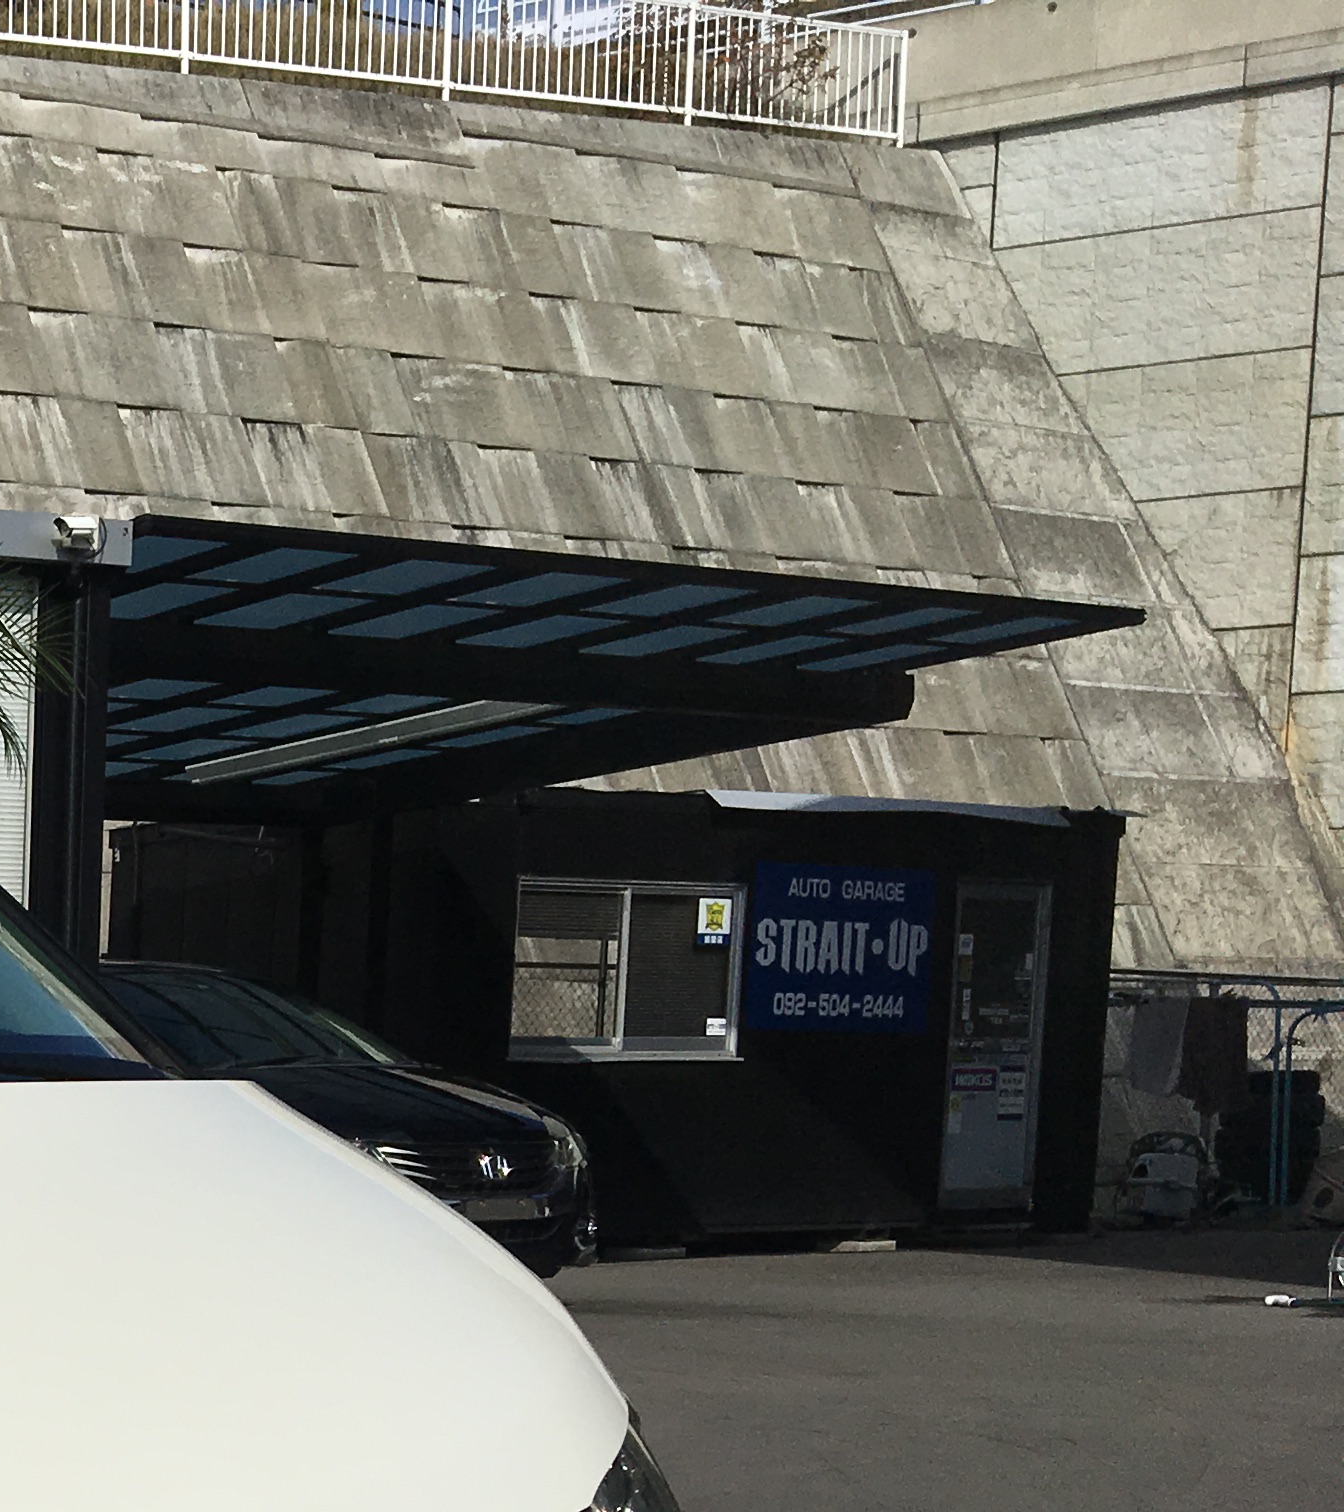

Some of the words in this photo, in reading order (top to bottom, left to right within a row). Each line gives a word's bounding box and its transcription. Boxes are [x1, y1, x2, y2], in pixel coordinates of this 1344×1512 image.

[787, 877, 831, 898] AUTO
[841, 880, 906, 902] GARAGE
[773, 991, 905, 1018] 092-504-2444
